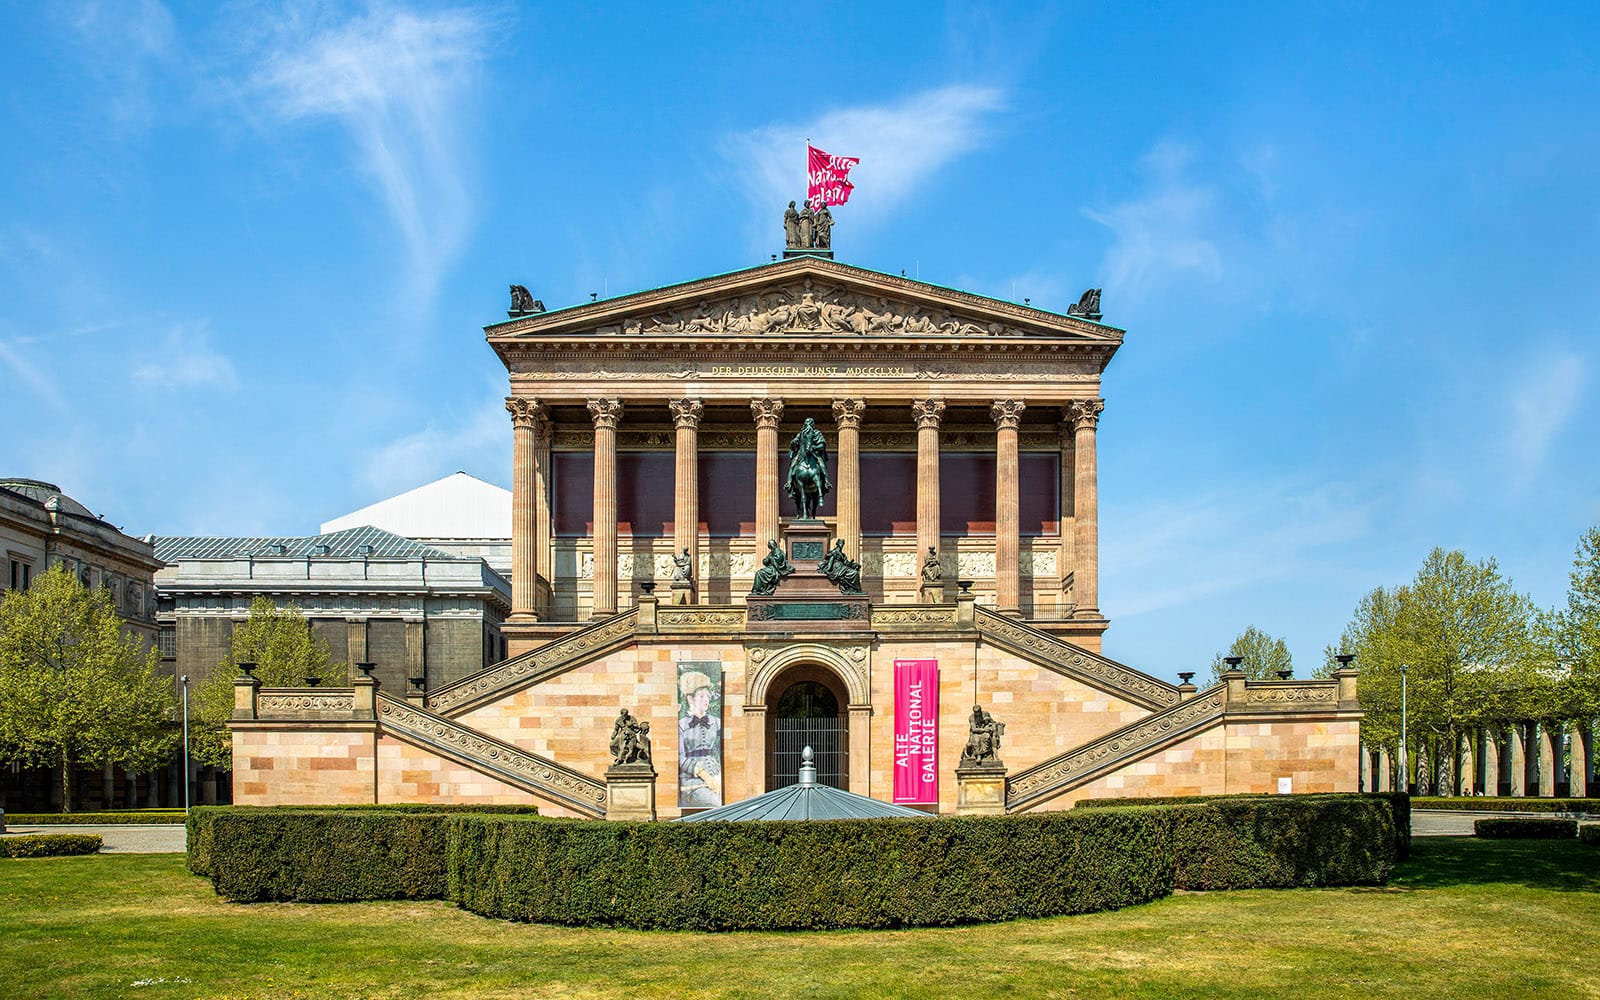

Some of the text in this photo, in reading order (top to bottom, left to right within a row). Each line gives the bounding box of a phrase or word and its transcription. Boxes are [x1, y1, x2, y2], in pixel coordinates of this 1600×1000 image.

[712, 366, 904, 375] DER DEUTSCHEN KUNST MDCCCLXXI
[909, 680, 922, 754] NATIONAL
[896, 734, 908, 767] ALTE
[922, 718, 935, 783] GALERIE
